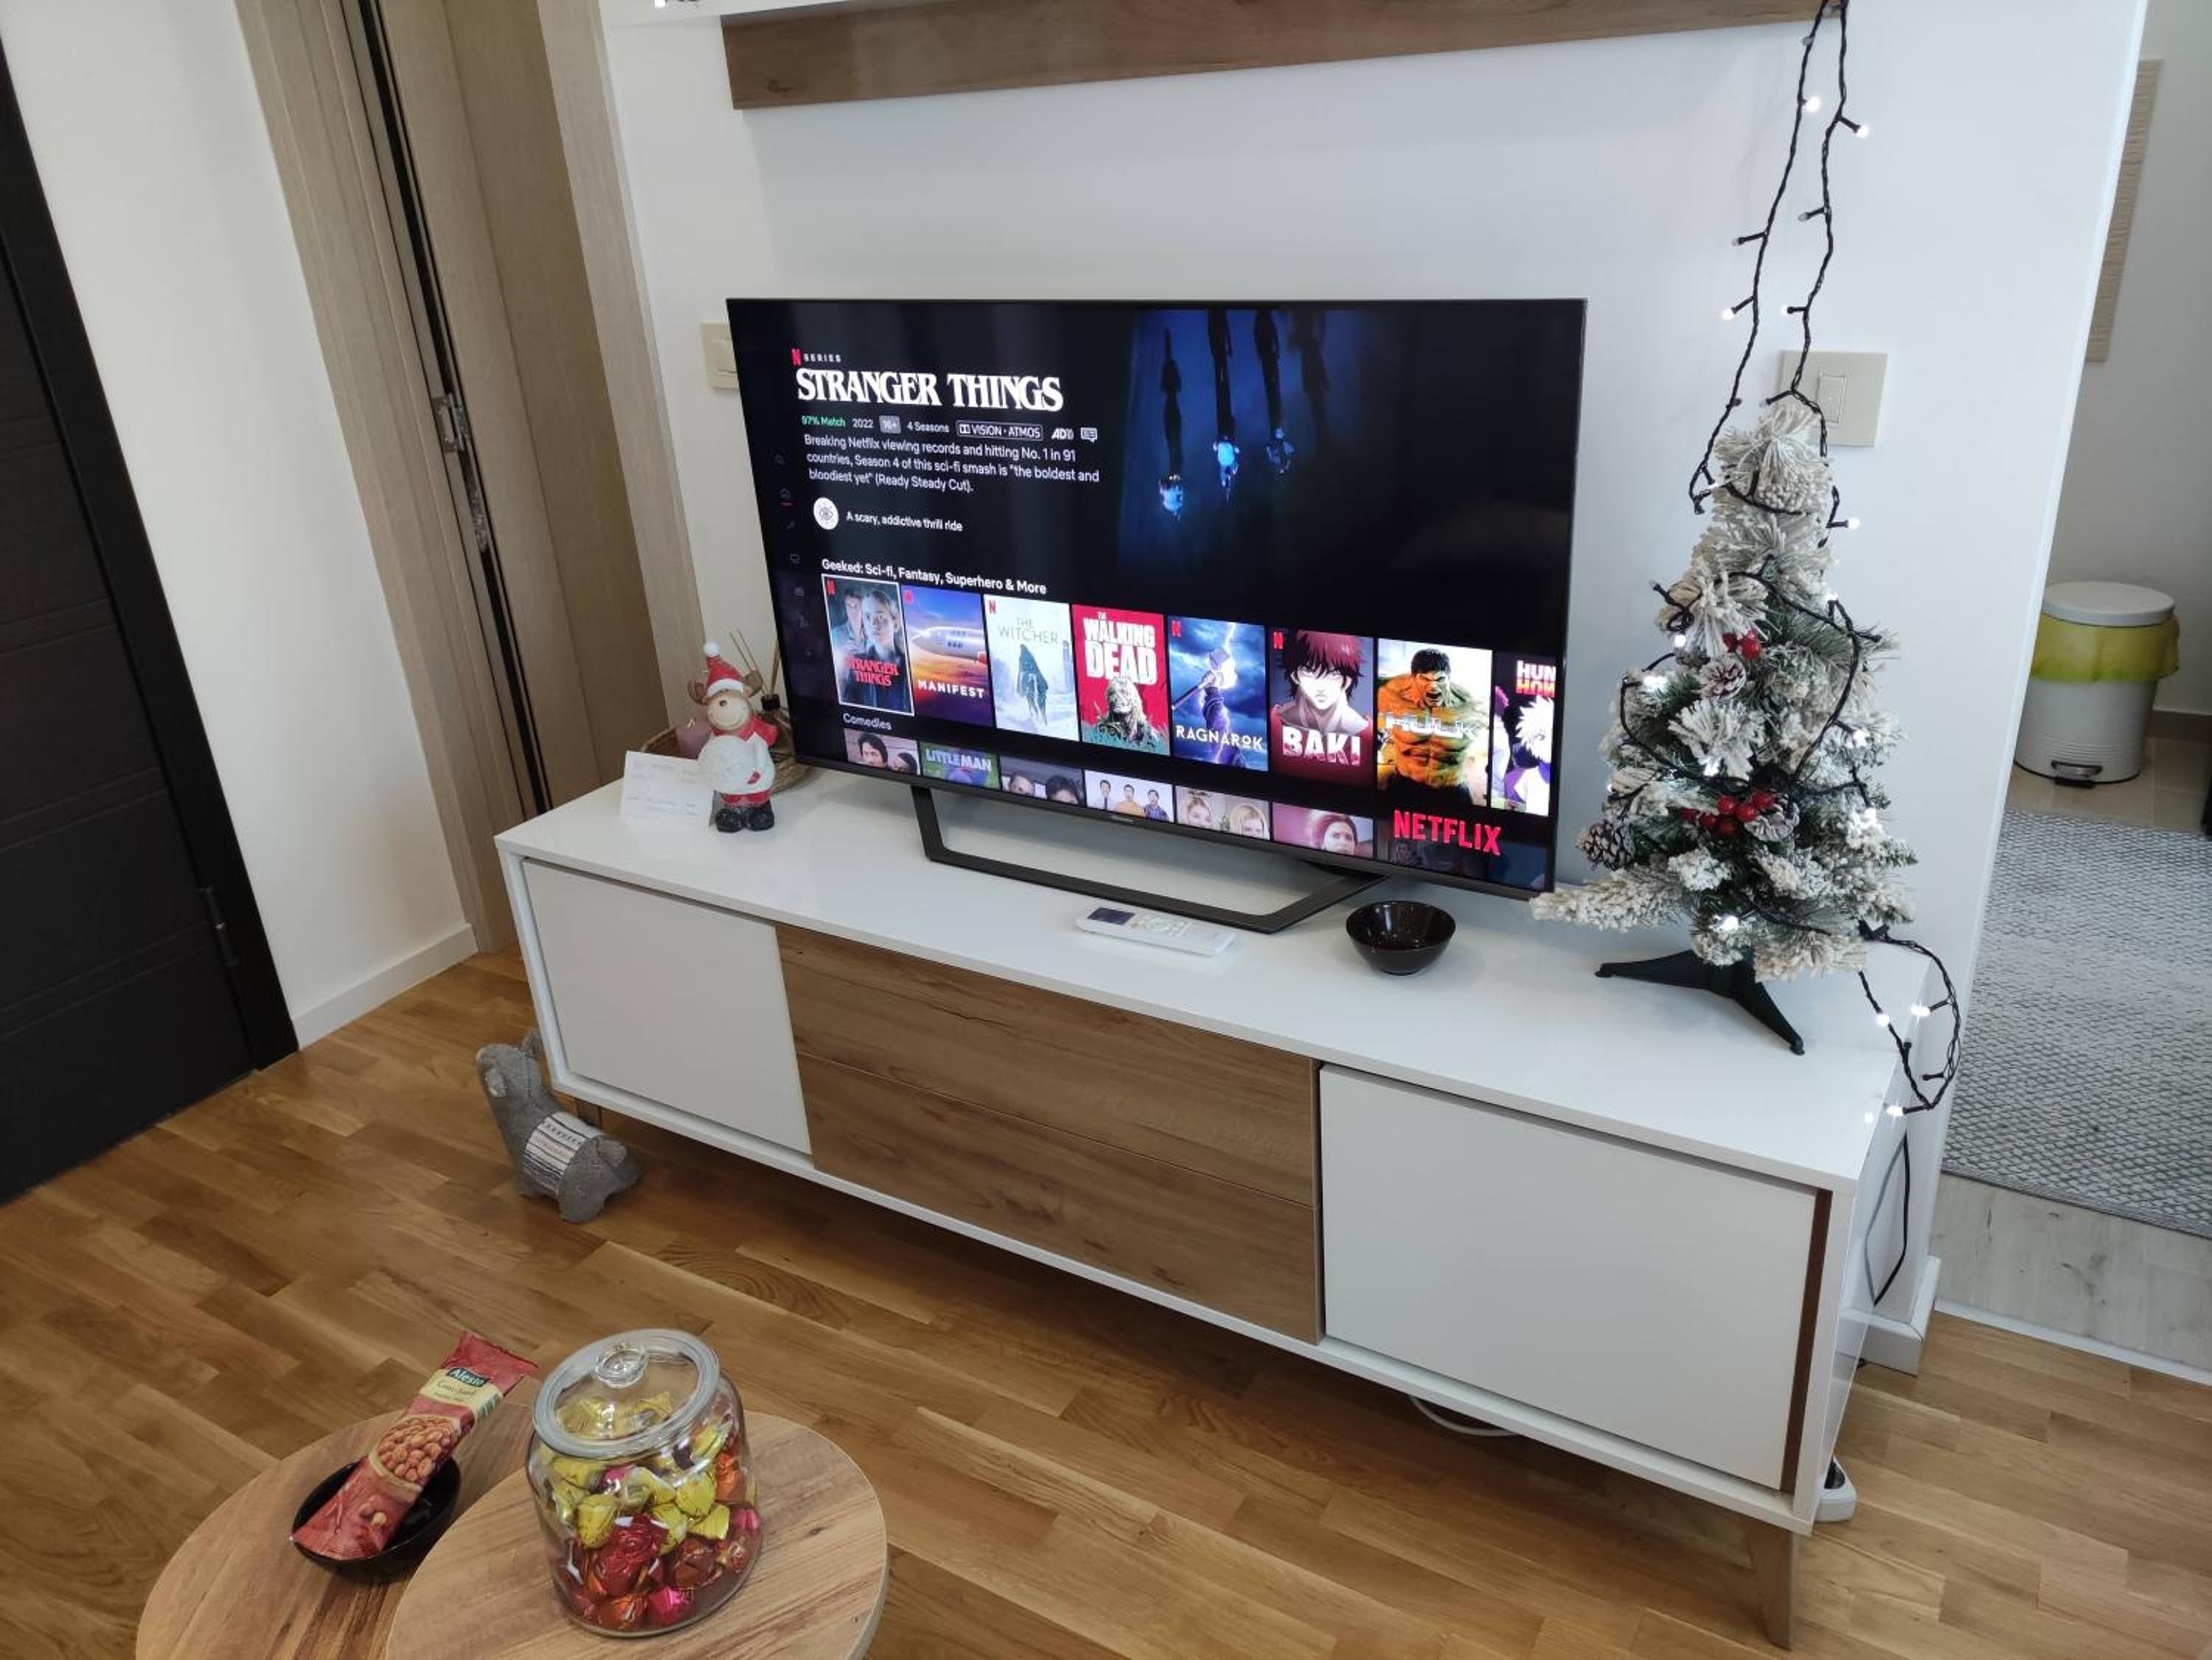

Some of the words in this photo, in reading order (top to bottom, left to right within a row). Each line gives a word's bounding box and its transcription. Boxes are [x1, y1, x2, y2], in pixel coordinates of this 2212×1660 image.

[803, 353, 841, 363] SERIES
[796, 368, 942, 405] STRANGER
[947, 373, 1063, 412] THINGS
[821, 416, 846, 427] Match
[852, 418, 873, 428] 2022
[907, 421, 914, 430] 4
[914, 421, 950, 433] Seasons
[972, 424, 1002, 436] VISION
[1008, 426, 1040, 438] ATMOS
[804, 433, 846, 450] Breaking
[848, 436, 880, 449] Netflix
[881, 439, 919, 455] viewing
[922, 442, 961, 455] records
[963, 444, 983, 456] and
[985, 444, 1019, 461] hitting
[1021, 447, 1040, 459] No.
[1043, 448, 1048, 459] 1
[1051, 450, 1060, 461] in
[1062, 449, 1076, 461] 91
[807, 452, 853, 467] countries,
[855, 454, 891, 468] Season
[892, 458, 900, 468] 4
[902, 458, 911, 470] of
[914, 458, 932, 471] this
[934, 459, 961, 473] sci-fi
[962, 462, 996, 475] smash
[998, 464, 1007, 476] is
[1009, 464, 1032, 478] "the
[1034, 466, 1075, 481] boldest
[1078, 470, 1099, 482] and
[809, 468, 852, 482] bloodiest
[854, 472, 874, 486] yet"
[875, 472, 908, 489] (Ready
[911, 475, 946, 492] Steady
[948, 478, 973, 493] Cut).
[846, 511, 853, 521] A
[855, 513, 880, 526] scary,
[882, 515, 922, 528] addictive
[922, 517, 942, 529] thrill
[945, 520, 963, 531] ride
[821, 558, 863, 574] Geeked:
[865, 562, 897, 579] Sci-fi,
[898, 567, 944, 585] Fantasy,
[945, 571, 1003, 590] Superhero
[1005, 579, 1015, 590] &
[1017, 580, 1047, 595] More
[998, 625, 1060, 644] WITCHER
[1016, 617, 1035, 629] THE
[1083, 617, 1155, 649] WALKING
[846, 657, 899, 676] STRANGER
[1085, 640, 1158, 686] DEAD
[854, 670, 891, 686] THINGS
[917, 679, 984, 699] MANIFEST
[843, 713, 892, 730] Comedies
[1175, 724, 1263, 751] RAGNAROK
[1282, 725, 1361, 766] BAKI
[925, 748, 961, 767] LITTLE
[961, 754, 992, 772] MAN
[1393, 810, 1501, 856] NETFLIX
